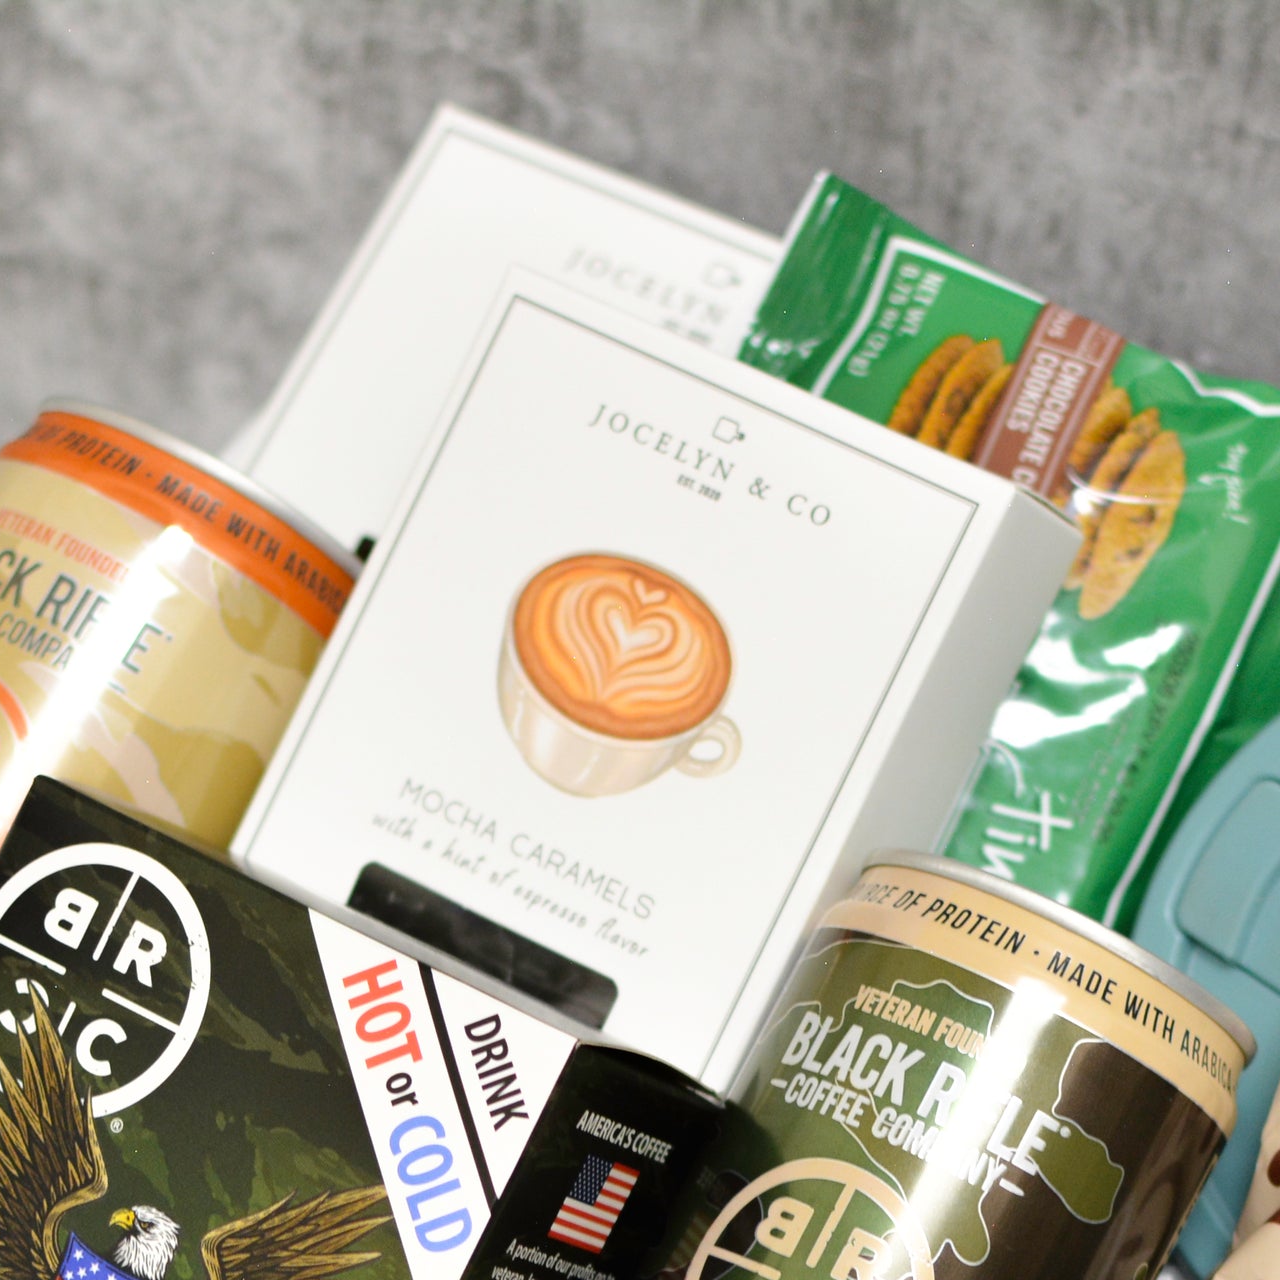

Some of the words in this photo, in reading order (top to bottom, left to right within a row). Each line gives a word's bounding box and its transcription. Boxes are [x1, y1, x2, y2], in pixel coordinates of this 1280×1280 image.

[914, 270, 946, 307] NET
[1006, 351, 1060, 433] COOKIES
[1019, 360, 1087, 467] CHOCOLATE
[588, 402, 736, 482] JOCELYN
[748, 476, 772, 501] &
[787, 493, 832, 527] CO
[156, 474, 223, 522] MADE
[226, 513, 281, 563] WITH
[35, 573, 164, 676] RIFE
[399, 777, 498, 845] MOCHA
[509, 832, 656, 922] CARAMELS
[341, 958, 423, 1074] HOT
[853, 983, 938, 1037] VETERAN
[922, 894, 1027, 956] PROTEIN
[1045, 950, 1119, 1006] MADE
[1123, 989, 1177, 1044] WITH
[384, 1070, 420, 1108] or
[463, 1013, 530, 1134] DRINK
[780, 1010, 926, 1108] BLACK
[783, 1071, 871, 1129] COFFEE
[387, 1114, 475, 1256] COLD
[575, 1109, 636, 1150] AMERICA'S
[630, 1131, 674, 1166] COFFEE
[505, 1238, 517, 1256] A
[511, 1243, 548, 1266] portion
[545, 1252, 561, 1269] of
